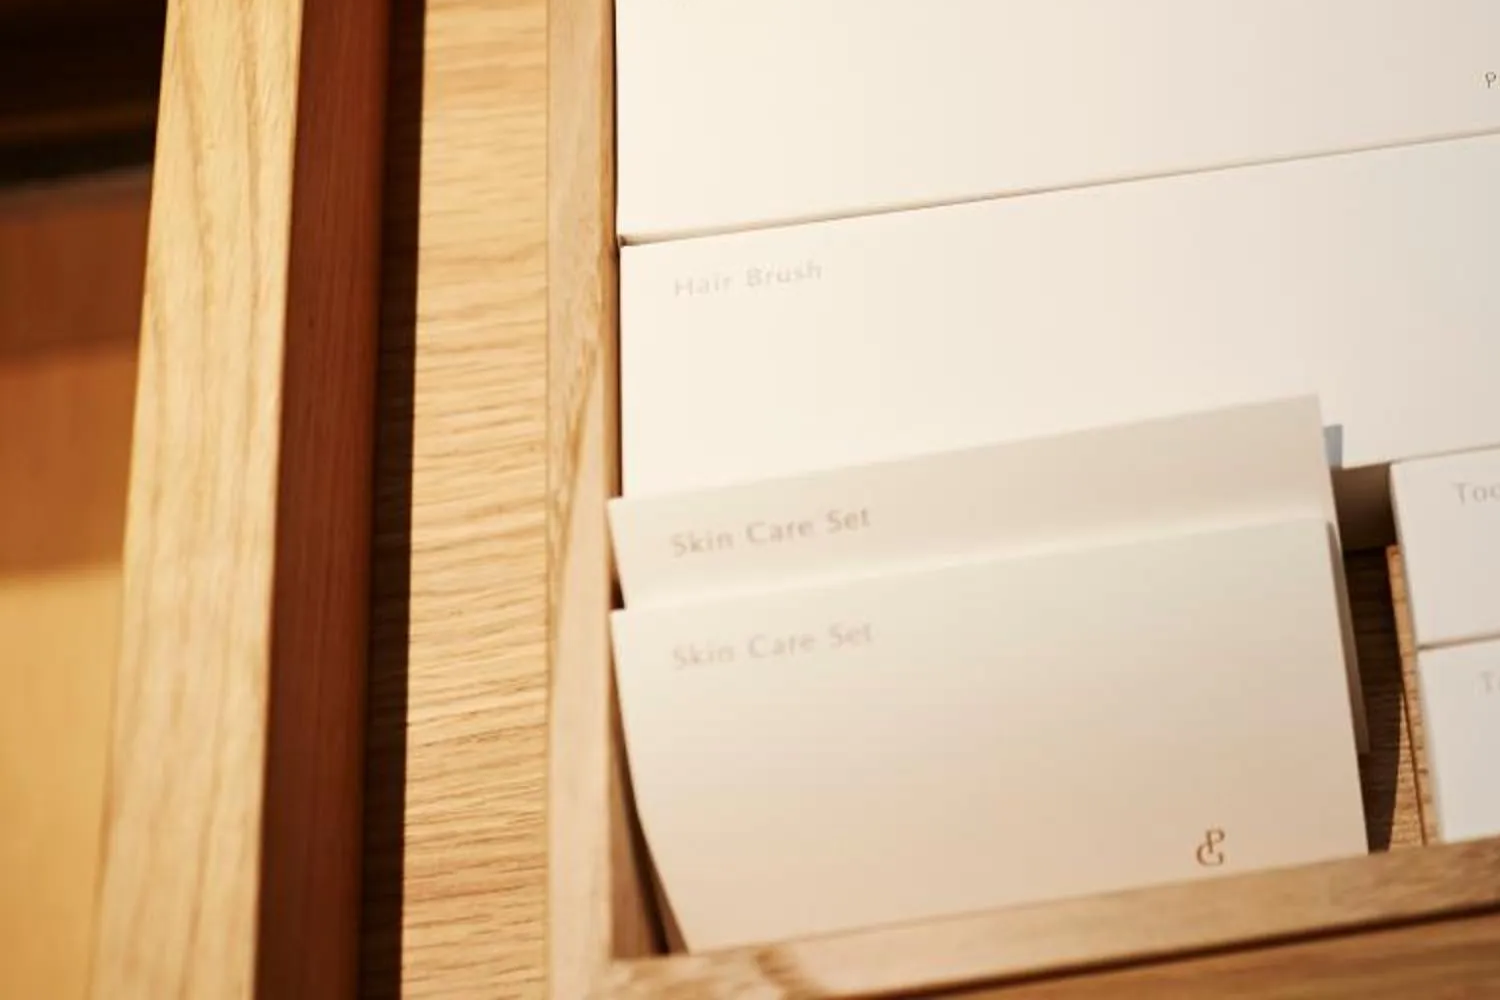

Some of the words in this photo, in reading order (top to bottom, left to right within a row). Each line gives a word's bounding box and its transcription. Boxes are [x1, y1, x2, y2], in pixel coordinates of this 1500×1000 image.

[673, 273, 733, 298] Hair
[745, 260, 824, 290] Brush
[669, 530, 735, 559] Skin
[745, 520, 815, 545] Care
[825, 507, 872, 535] Set
[671, 643, 736, 671] Skin
[746, 632, 817, 660] Care
[827, 621, 873, 650] Set
